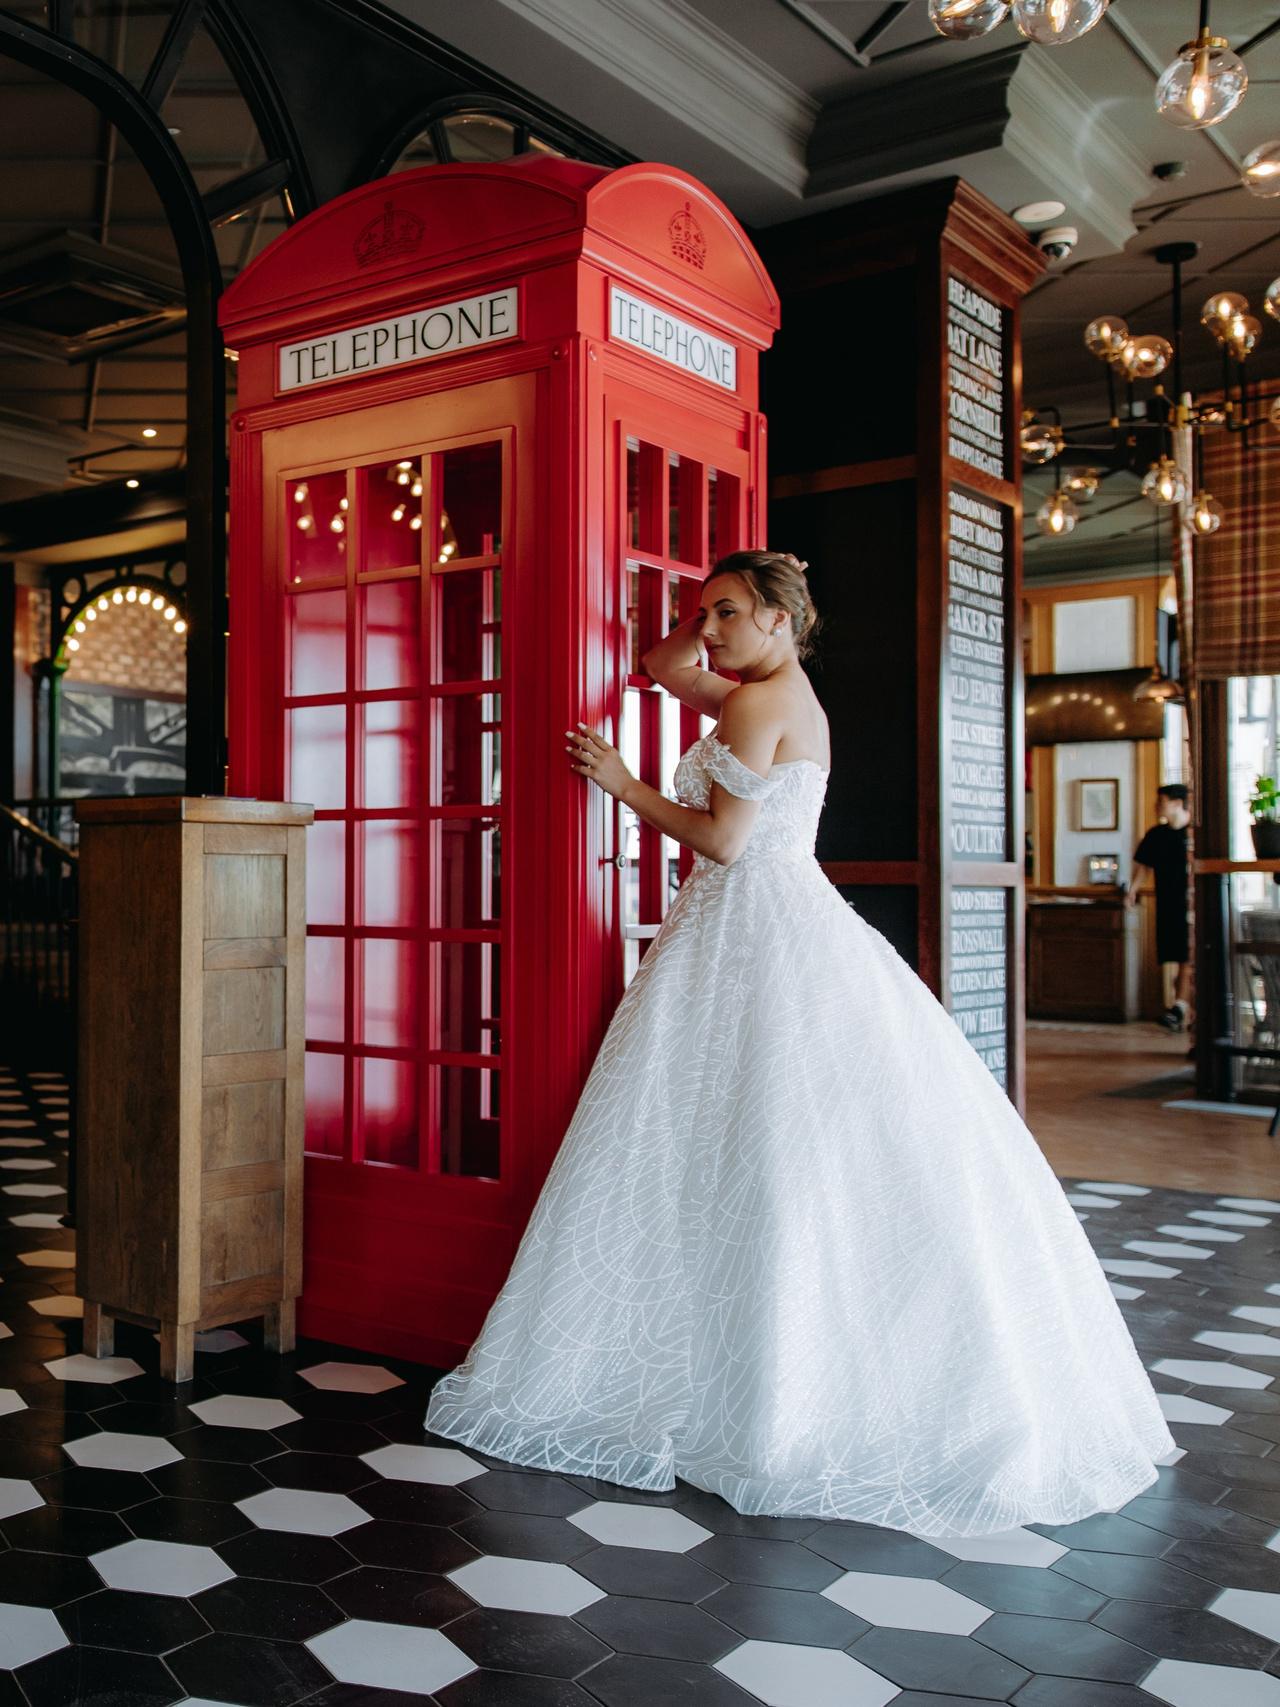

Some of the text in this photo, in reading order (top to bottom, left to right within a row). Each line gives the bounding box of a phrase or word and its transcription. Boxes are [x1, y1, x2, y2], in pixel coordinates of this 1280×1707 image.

[290, 294, 510, 385] TELEPHONE
[615, 295, 732, 386] TELEPHONE
[969, 335, 1002, 378] LANE
[949, 389, 1003, 440] ORNHILL
[975, 524, 1003, 553] ROAD
[978, 570, 1004, 597] ROW
[987, 614, 1005, 643] ST
[974, 641, 1005, 666] STREET
[951, 674, 1005, 707] LD JEWRY
[969, 723, 1005, 748] STREET
[950, 890, 1006, 910] OOD STREET
[979, 1007, 1006, 1032] HILL
